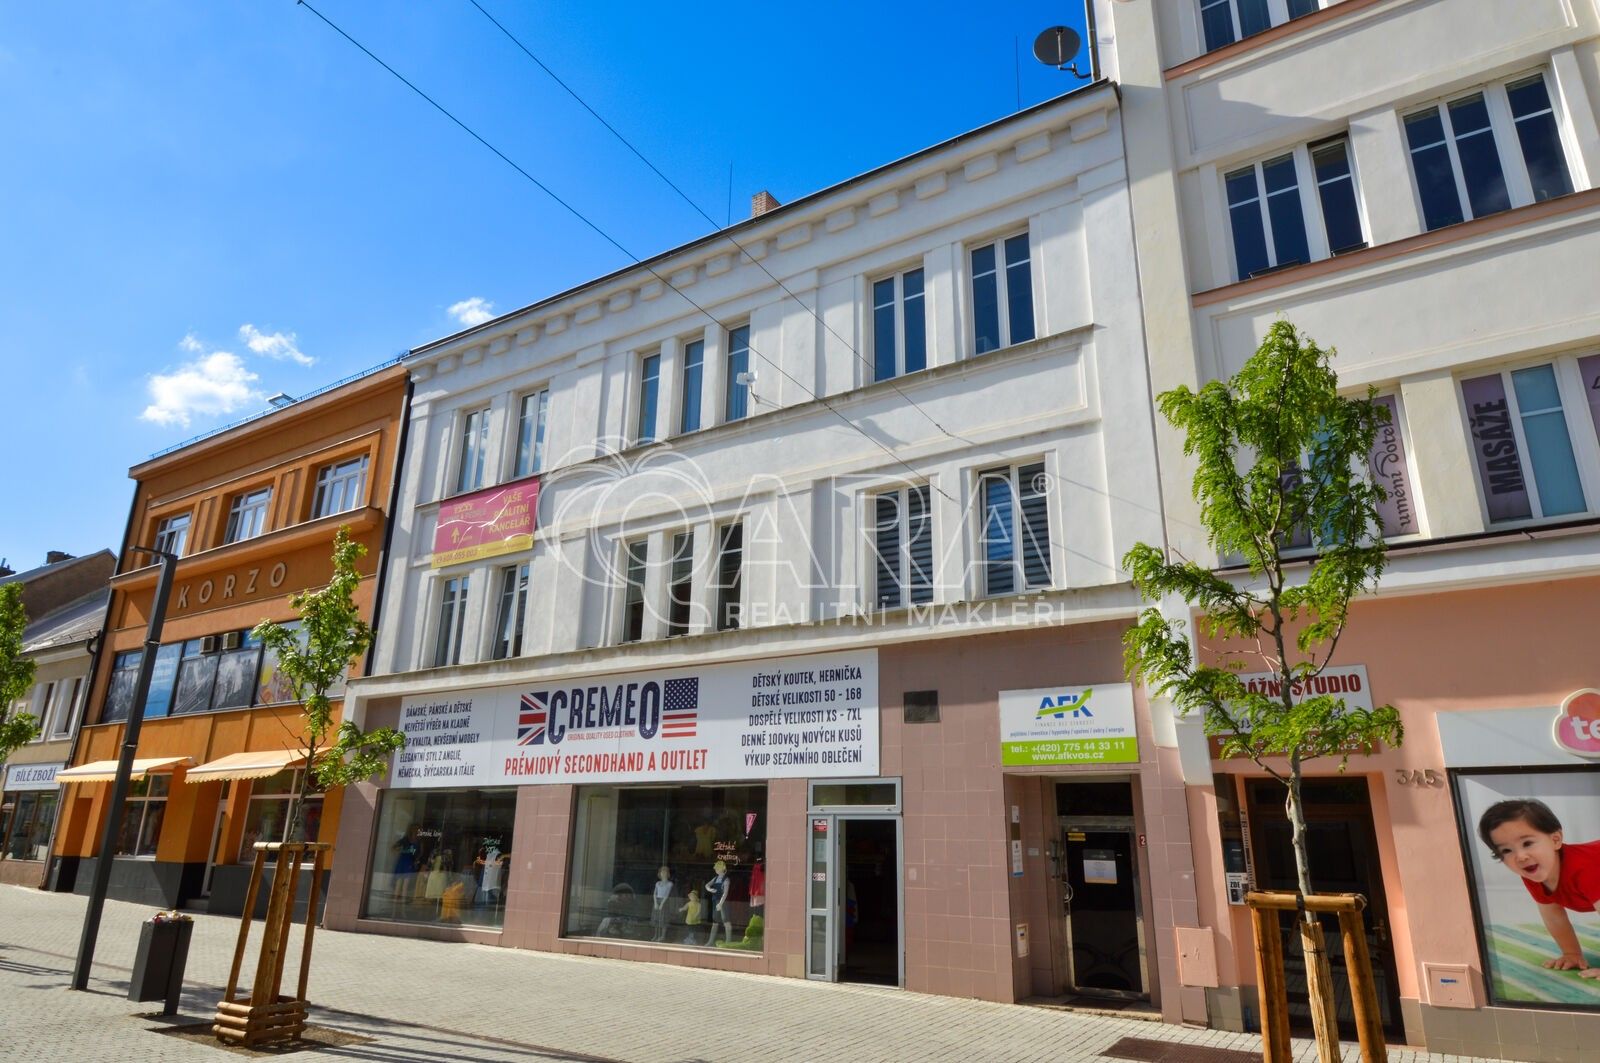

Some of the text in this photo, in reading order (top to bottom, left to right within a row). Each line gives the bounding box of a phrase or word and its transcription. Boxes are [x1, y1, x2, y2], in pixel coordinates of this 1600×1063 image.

[1473, 398, 1524, 495] MASÁŽE
[177, 561, 286, 609] KORZO
[752, 665, 862, 688] DĚTSKÝ KOUTEK, HERNIČKA
[1292, 674, 1362, 696] STUDIO
[429, 702, 448, 715] PÁNSKÉ
[454, 699, 473, 713] DĚTSKÉ
[752, 689, 780, 707] DĚTSKÉ
[782, 690, 822, 705] VELIKOSTI
[824, 689, 836, 702] 50
[845, 687, 862, 701] 168
[1035, 694, 1094, 720] AFK
[547, 681, 661, 745] CREMEO
[749, 708, 782, 727] DOSPĚLÉ
[784, 710, 824, 725] VELIKOSTI
[826, 709, 837, 722] XS
[847, 707, 862, 721] 7XL
[426, 718, 441, 731] VÝBĚR
[442, 720, 450, 730] NA
[450, 716, 470, 729] KLADNĚ
[460, 733, 480, 744] MODELY
[741, 724, 862, 748] DENNĚ 100vky NOVÝCH KUSŮ
[426, 752, 438, 762] STYL
[744, 745, 862, 766] VÝKUP SEZÓNNÍHO OBLEČENÍ
[1032, 742, 1060, 754] +(420)
[1064, 742, 1080, 752] 775
[1083, 742, 1095, 751] 44
[1098, 742, 1110, 750] 33
[1114, 741, 1125, 750] 11
[459, 762, 475, 776] ITÁLIE
[504, 749, 708, 776] PRÉMIOVÝ SECONDHAND A OUTLET
[16, 768, 32, 782] BÍLÉ
[1396, 769, 1436, 786] 345
